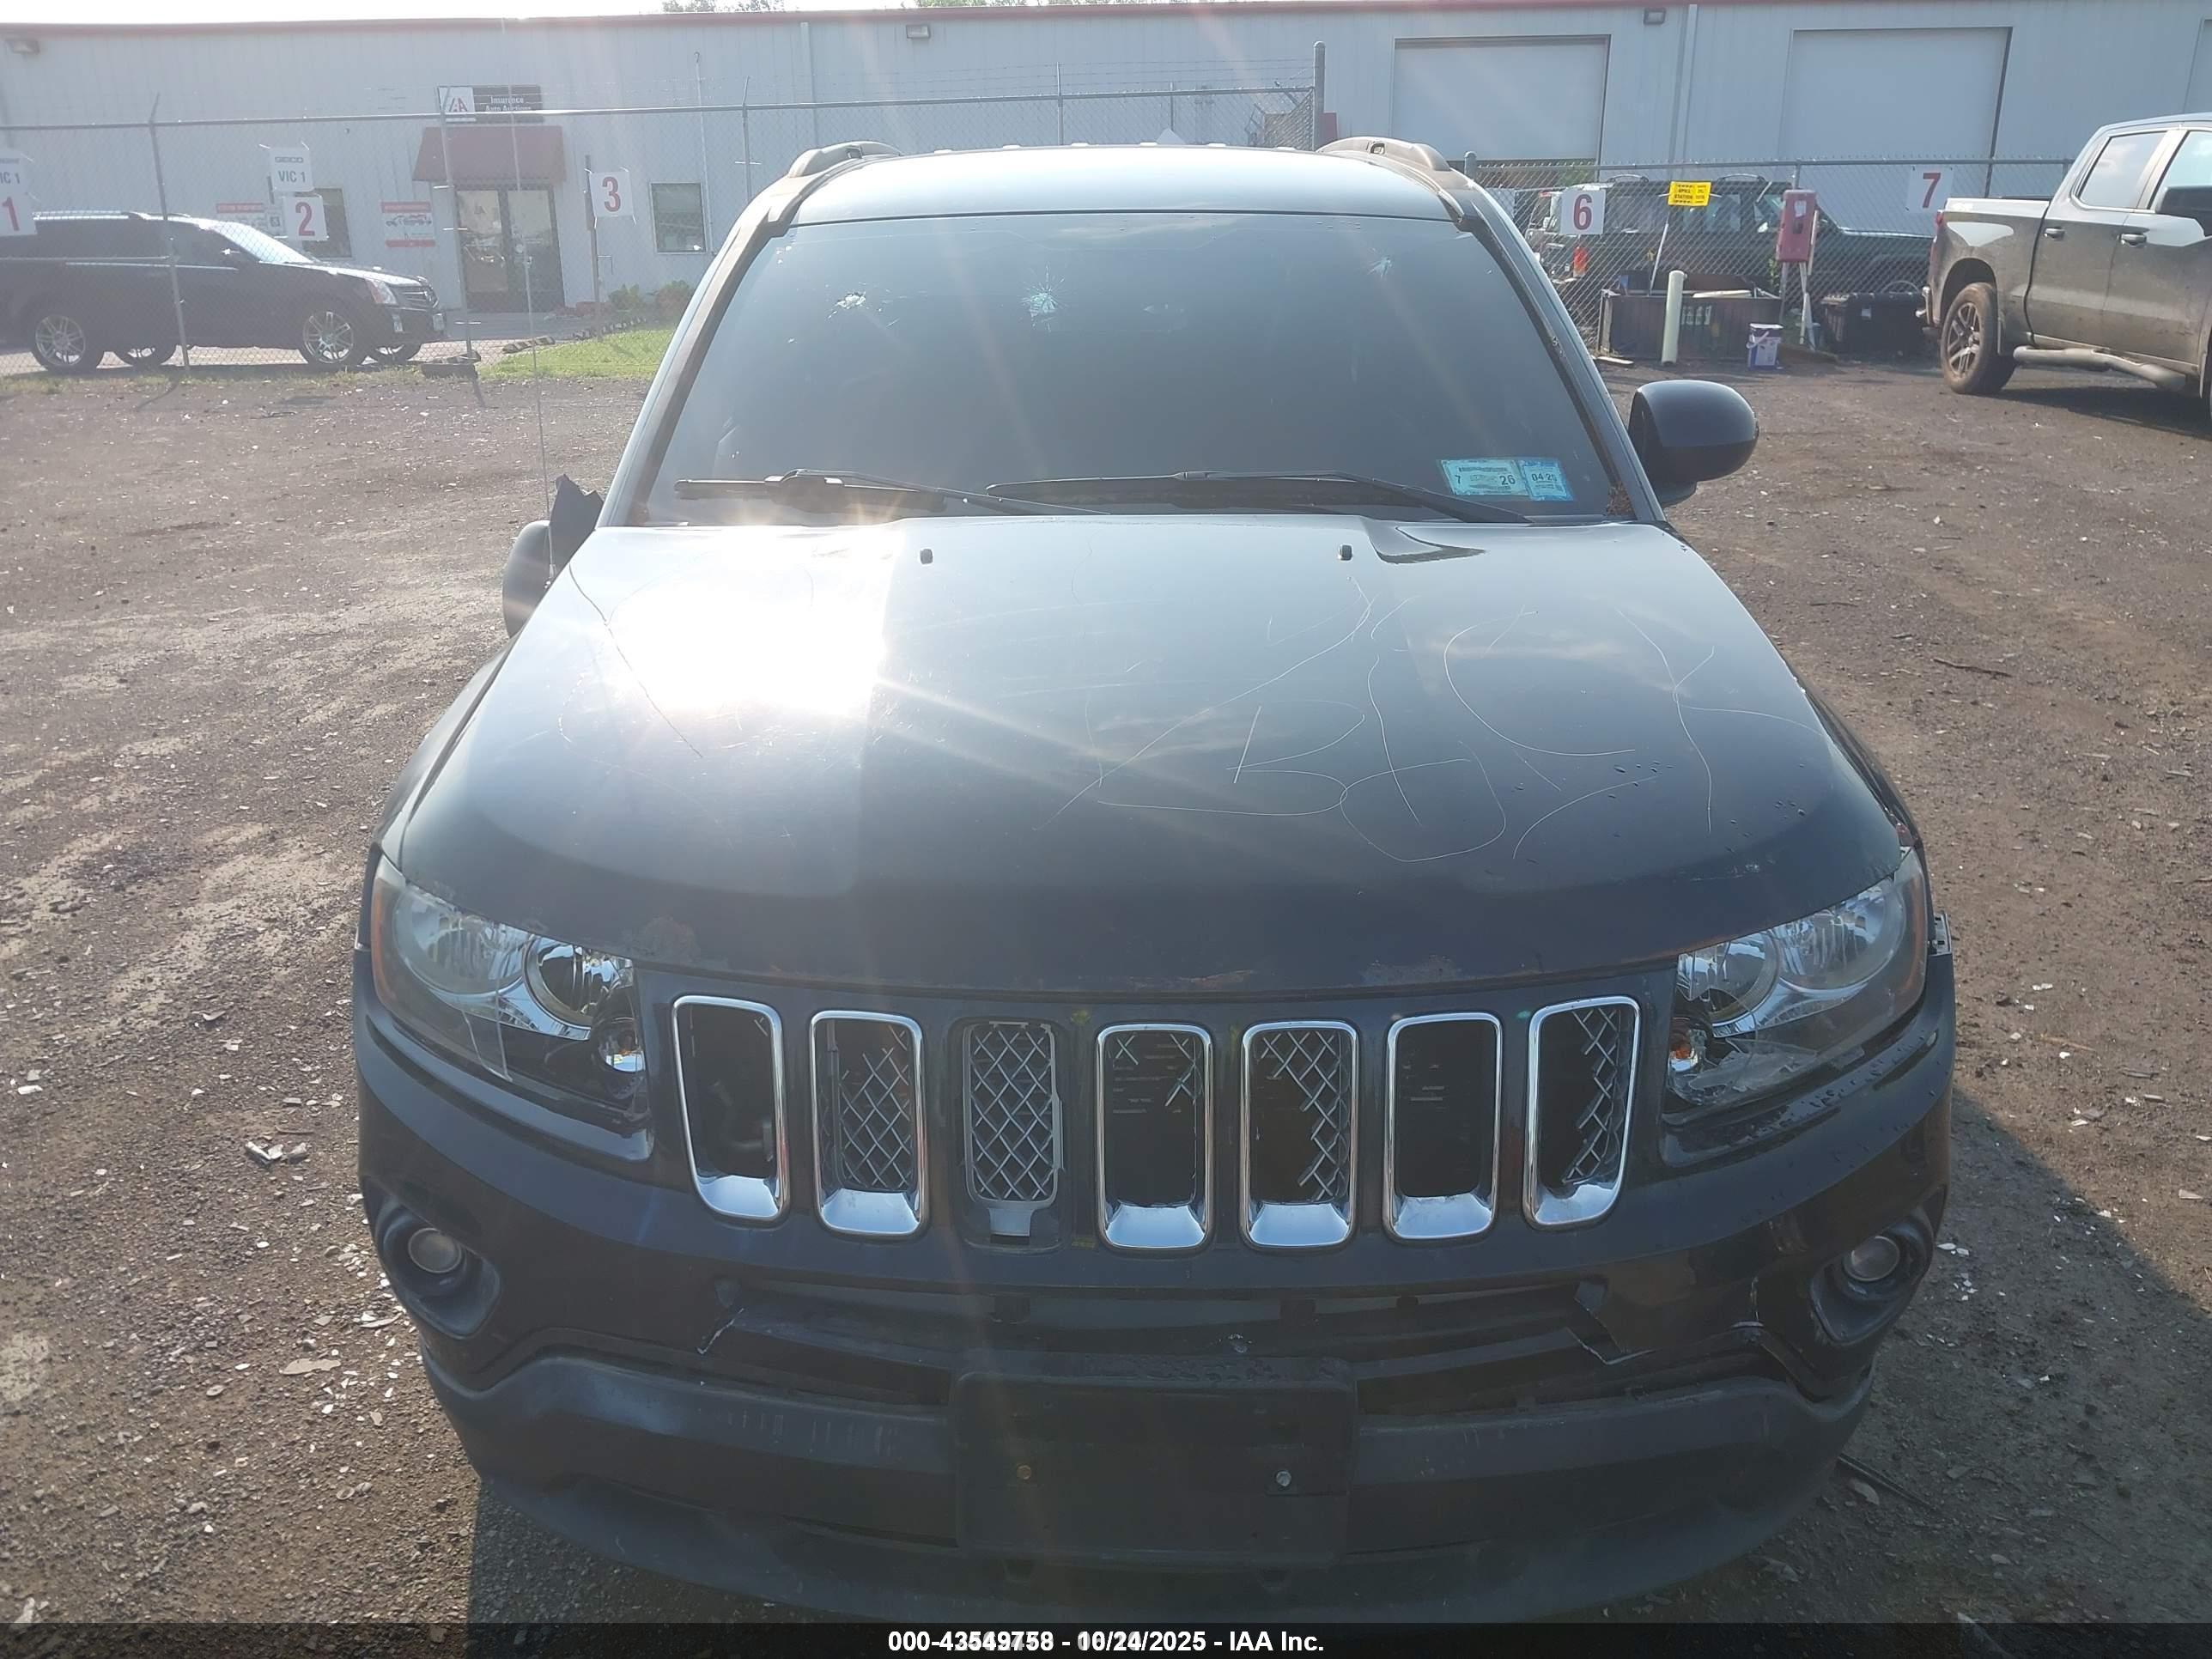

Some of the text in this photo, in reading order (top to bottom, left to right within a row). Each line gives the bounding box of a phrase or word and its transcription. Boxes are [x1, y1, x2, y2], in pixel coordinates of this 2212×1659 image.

[278, 171, 306, 183] VIC 1
[1923, 173, 1941, 208] 7
[603, 177, 621, 212] 3
[3, 197, 20, 231] 1
[295, 202, 315, 236] 2
[1574, 194, 1592, 230] 6
[1499, 474, 1516, 485] 26
